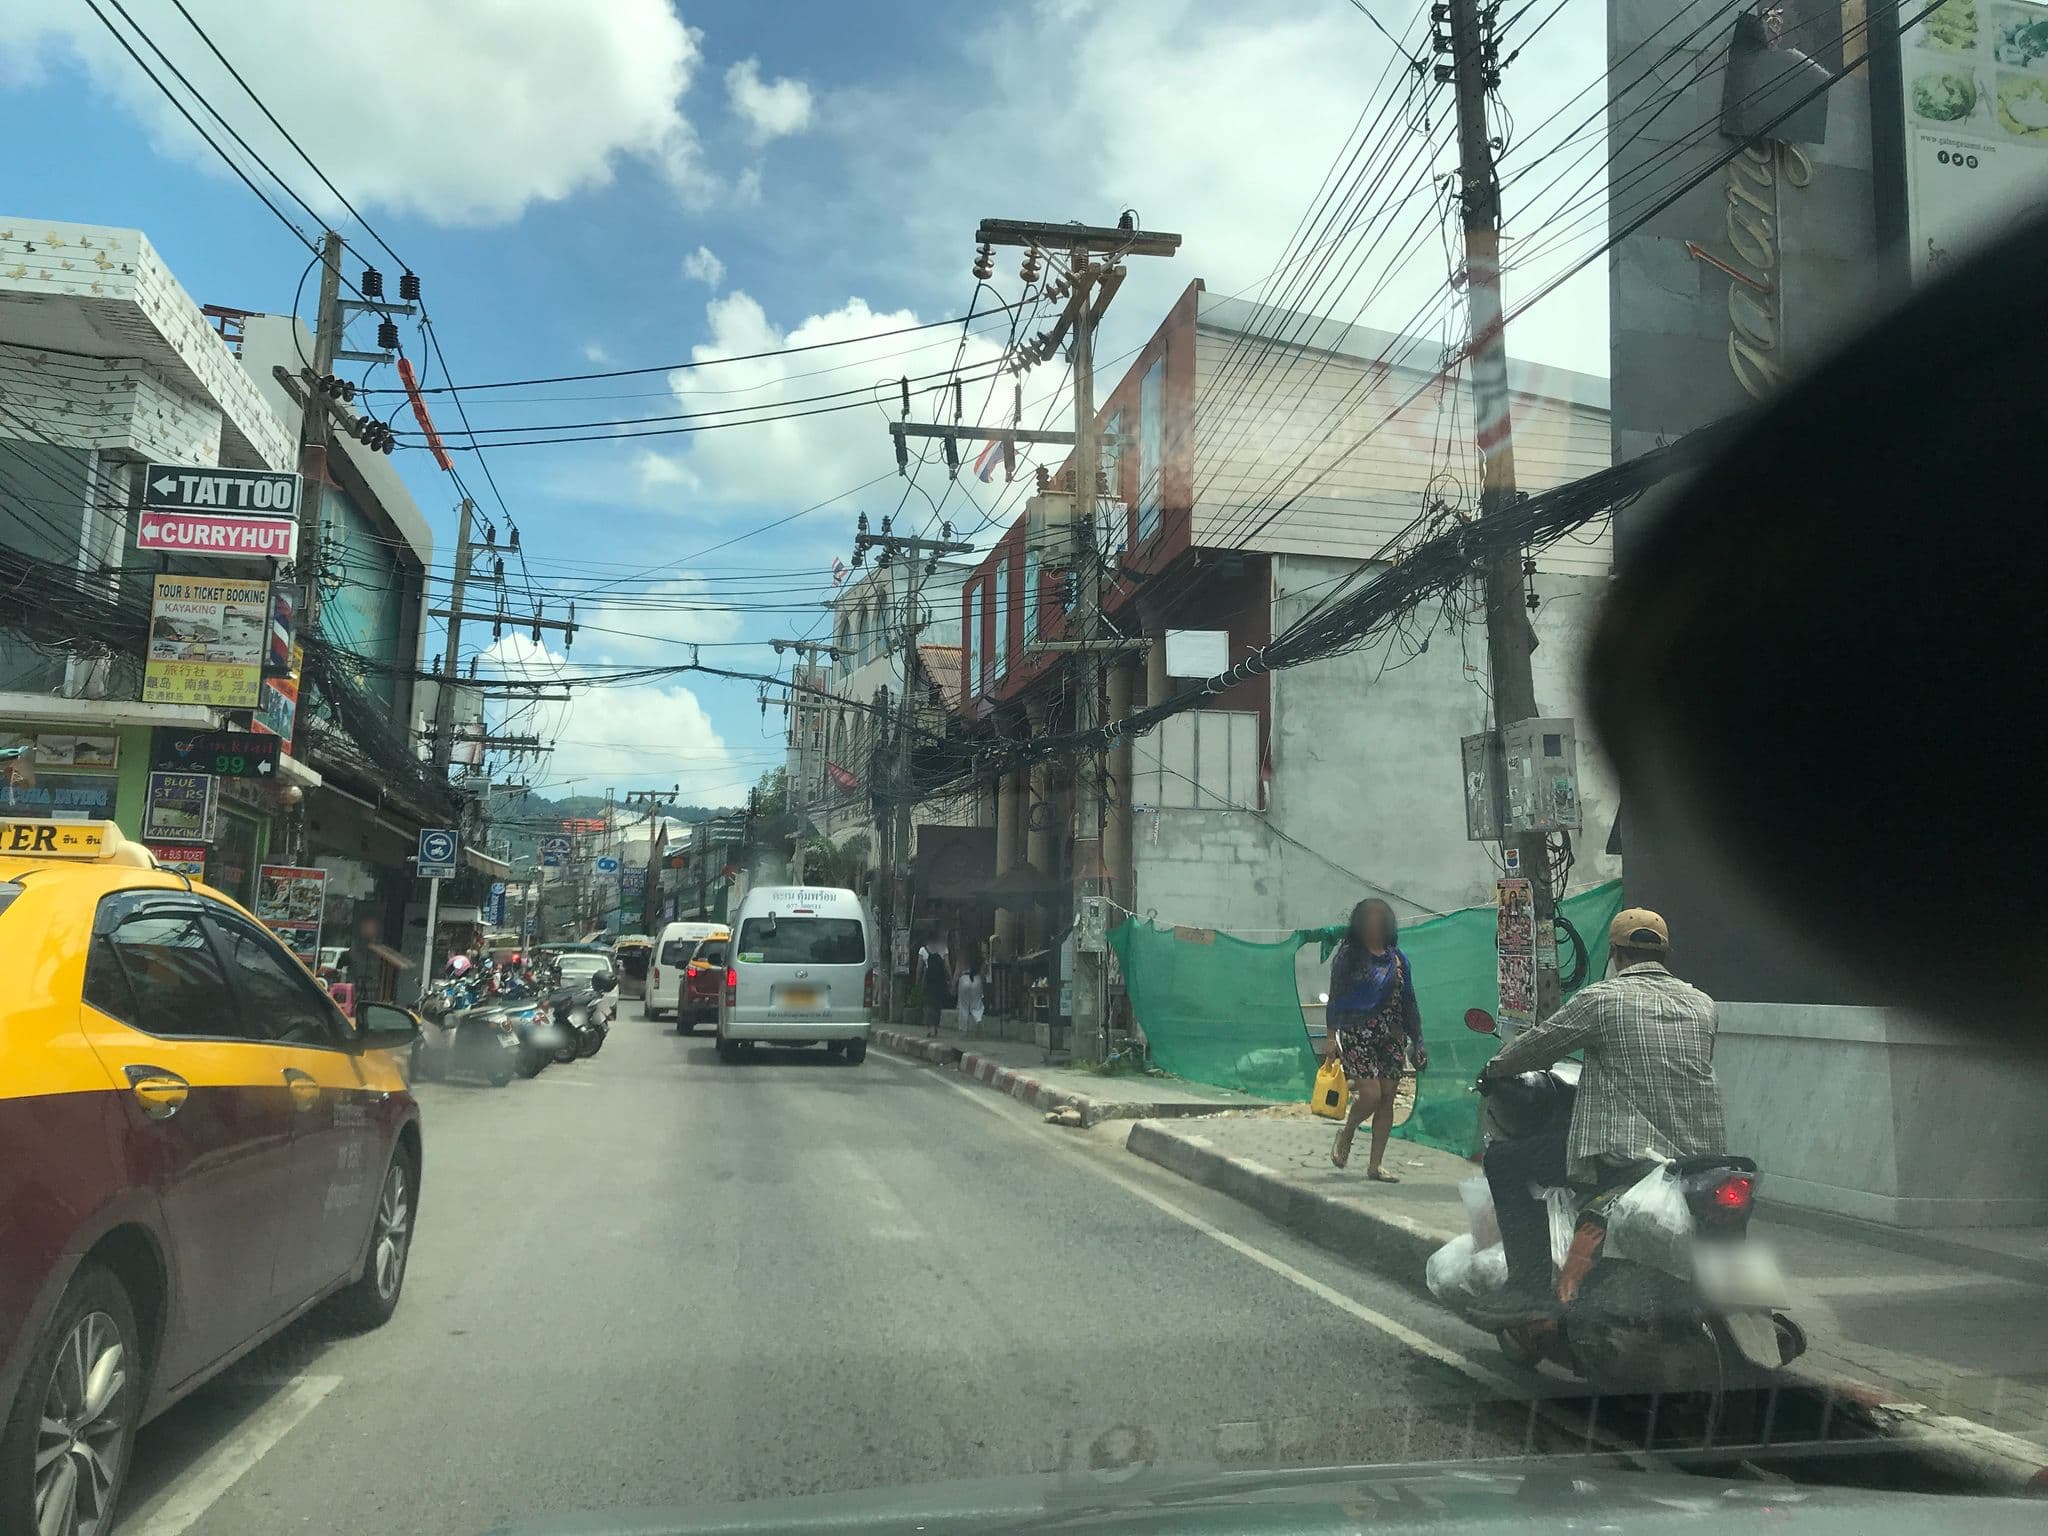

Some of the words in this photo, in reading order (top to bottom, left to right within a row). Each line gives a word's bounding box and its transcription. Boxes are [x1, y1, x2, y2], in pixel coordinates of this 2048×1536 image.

[178, 475, 292, 509] TATTOO
[161, 522, 289, 549] CURRYHUT
[158, 584, 182, 598] TOUR
[184, 586, 191, 598] &
[194, 586, 225, 600] TICKET
[226, 589, 265, 603] BOOKING
[165, 603, 217, 615] KAYAKING
[215, 755, 245, 774] 99
[164, 777, 196, 788] BLUE
[154, 787, 205, 799] STRS
[148, 827, 202, 838] KAYAKING
